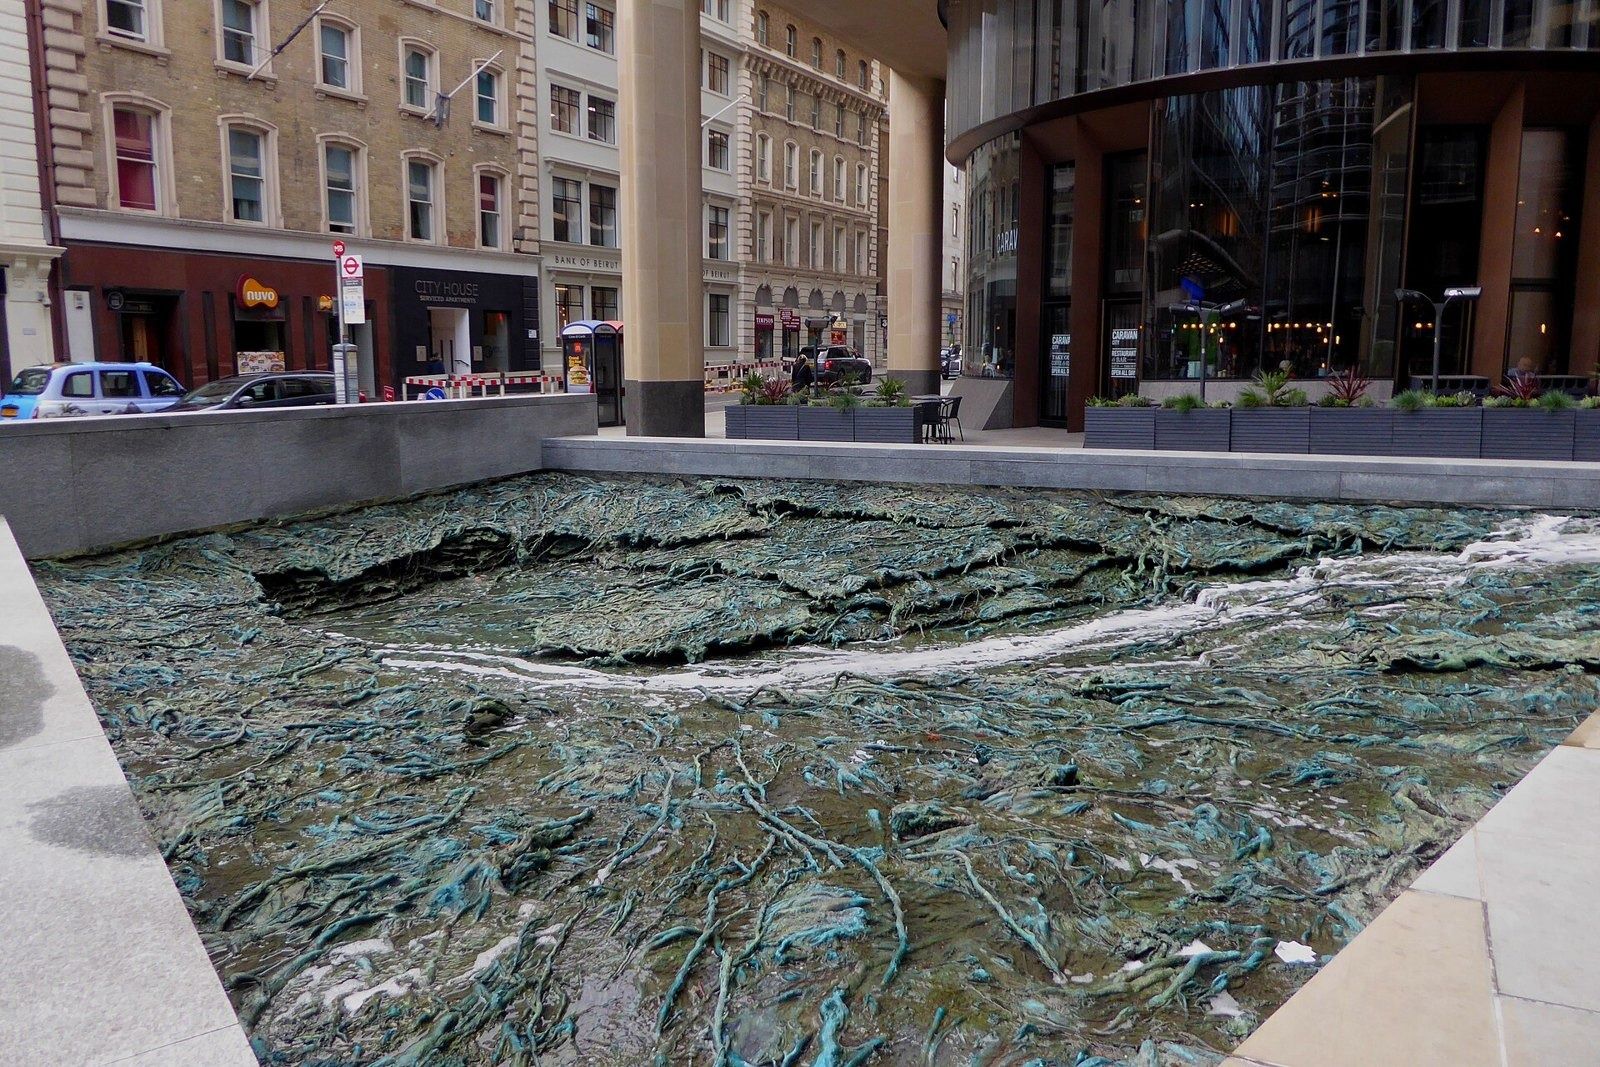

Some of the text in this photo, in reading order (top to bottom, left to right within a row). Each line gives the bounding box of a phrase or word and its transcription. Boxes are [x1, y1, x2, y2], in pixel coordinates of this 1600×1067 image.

[555, 256, 618, 268] BANK OF BEIRUT
[711, 270, 730, 278] BEIRUT
[415, 280, 479, 296] CITY HOUSE
[247, 290, 275, 301] nuvo
[1112, 331, 1137, 340] CARAVAN
